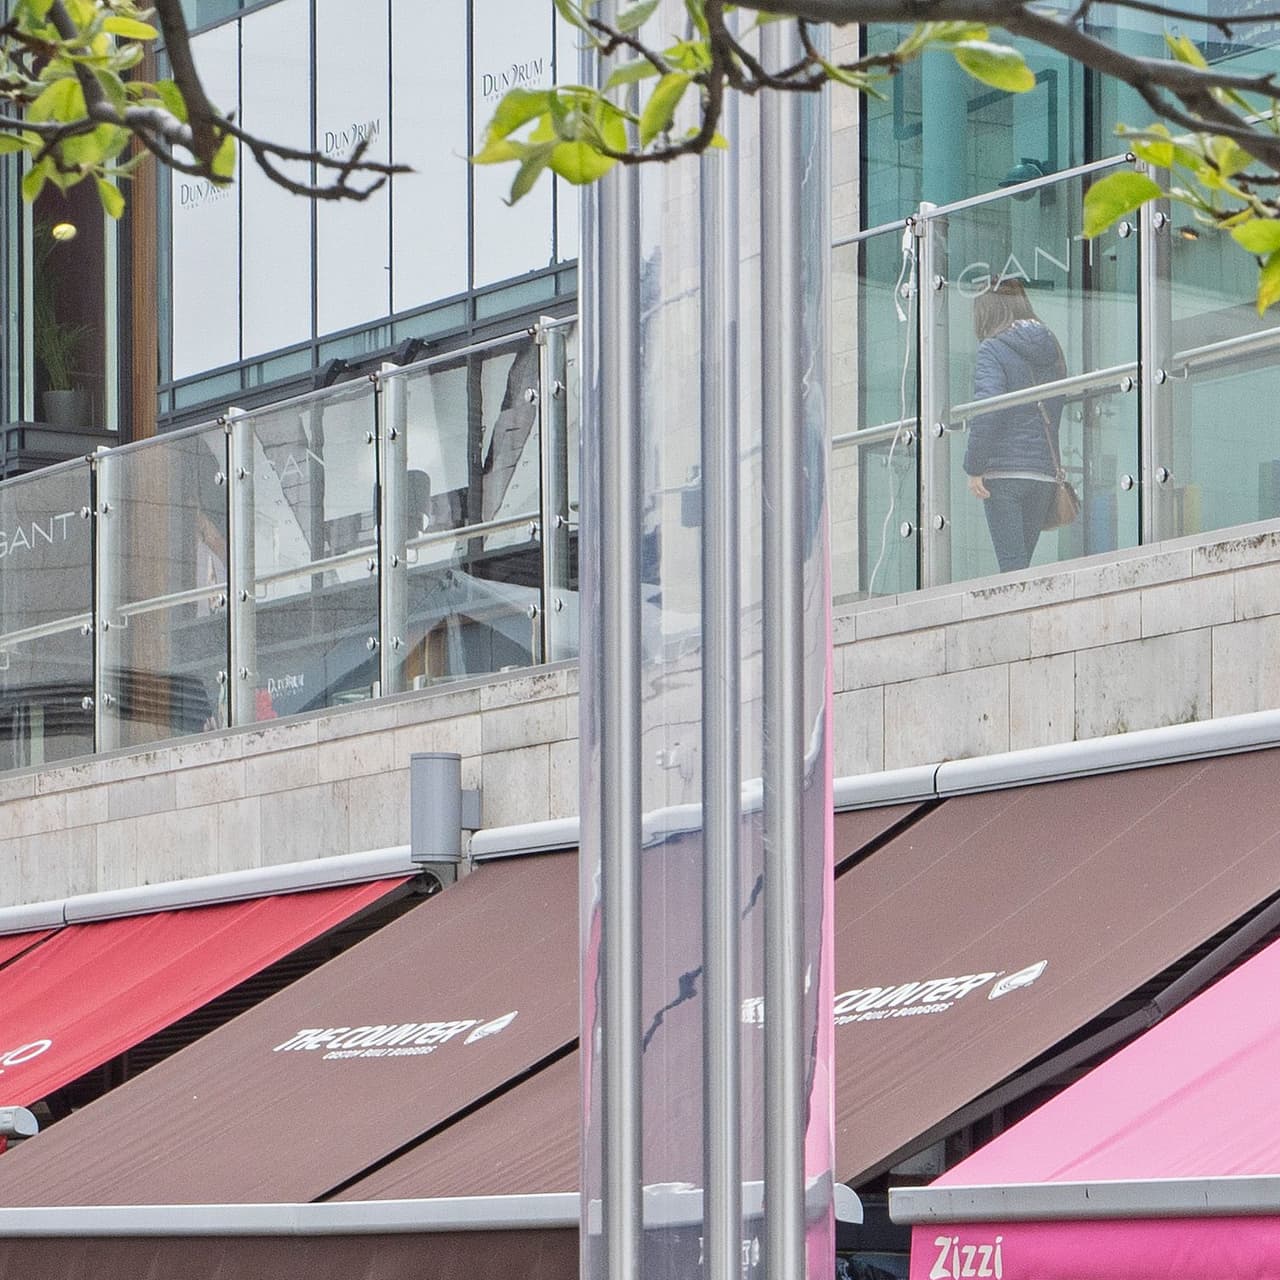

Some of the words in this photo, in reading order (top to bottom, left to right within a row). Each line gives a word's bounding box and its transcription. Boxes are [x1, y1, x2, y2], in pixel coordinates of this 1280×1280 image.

[957, 230, 1108, 298] GANT
[0, 511, 76, 560] ANT
[327, 1019, 477, 1049] COUNTER
[929, 1236, 1003, 1280] Zizzi
